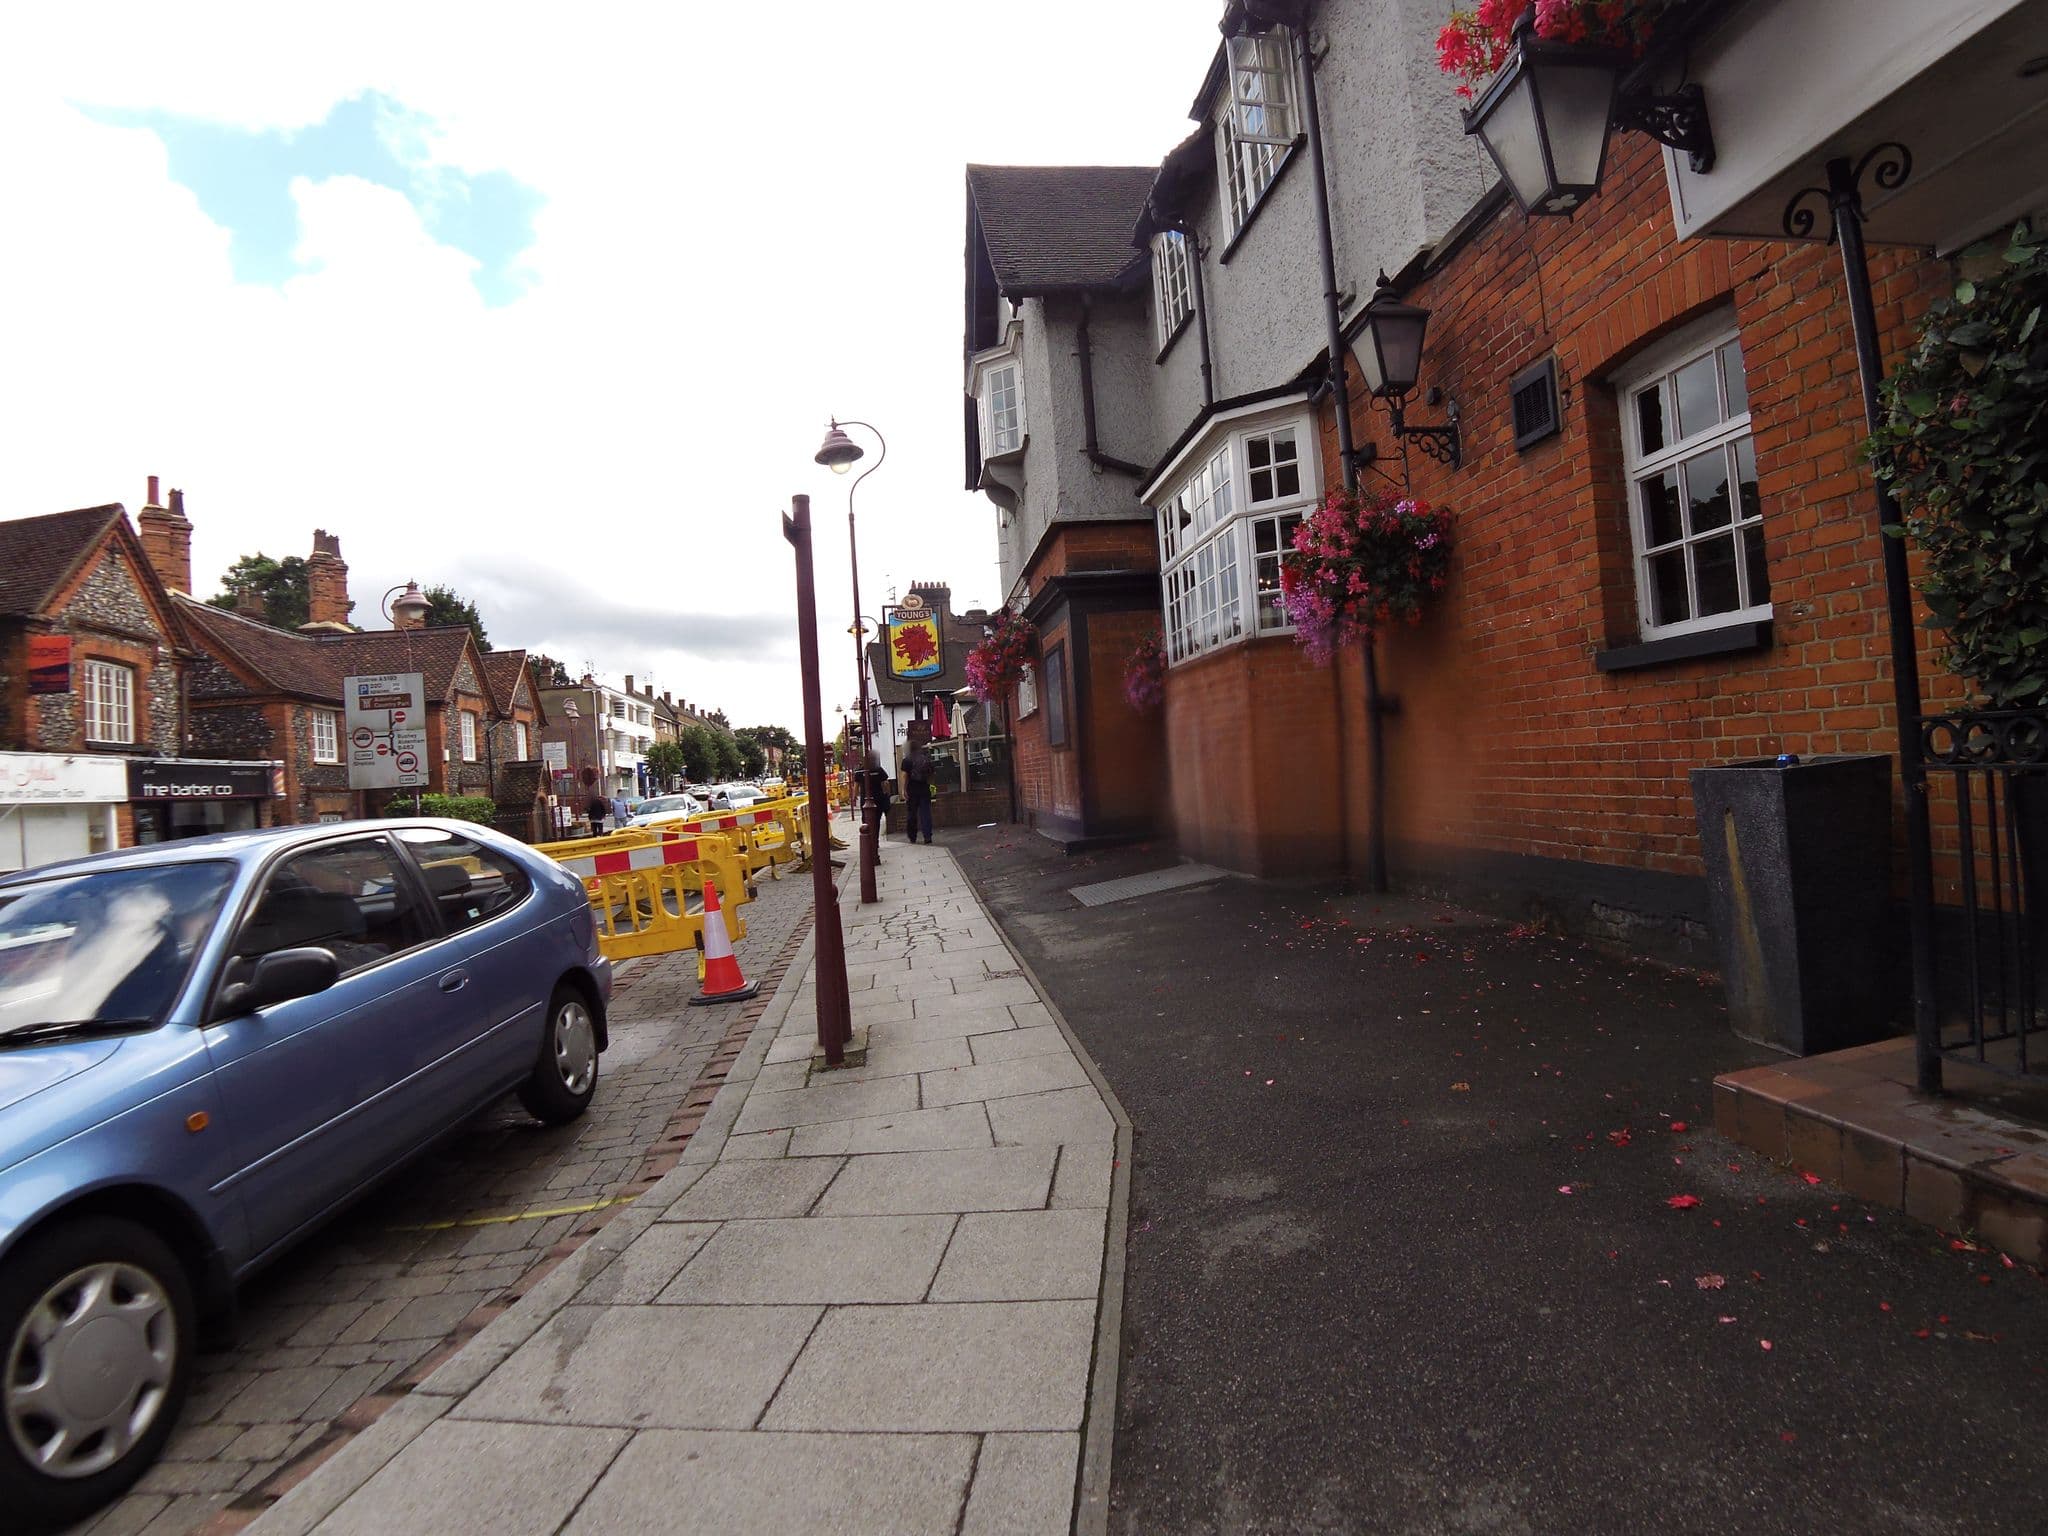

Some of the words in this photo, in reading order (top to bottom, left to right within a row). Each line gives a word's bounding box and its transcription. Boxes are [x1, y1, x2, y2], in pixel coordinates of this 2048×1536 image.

[896, 609, 930, 619] YOUNG'S
[143, 783, 168, 796] the
[170, 783, 213, 796] barber
[215, 784, 233, 795] co
